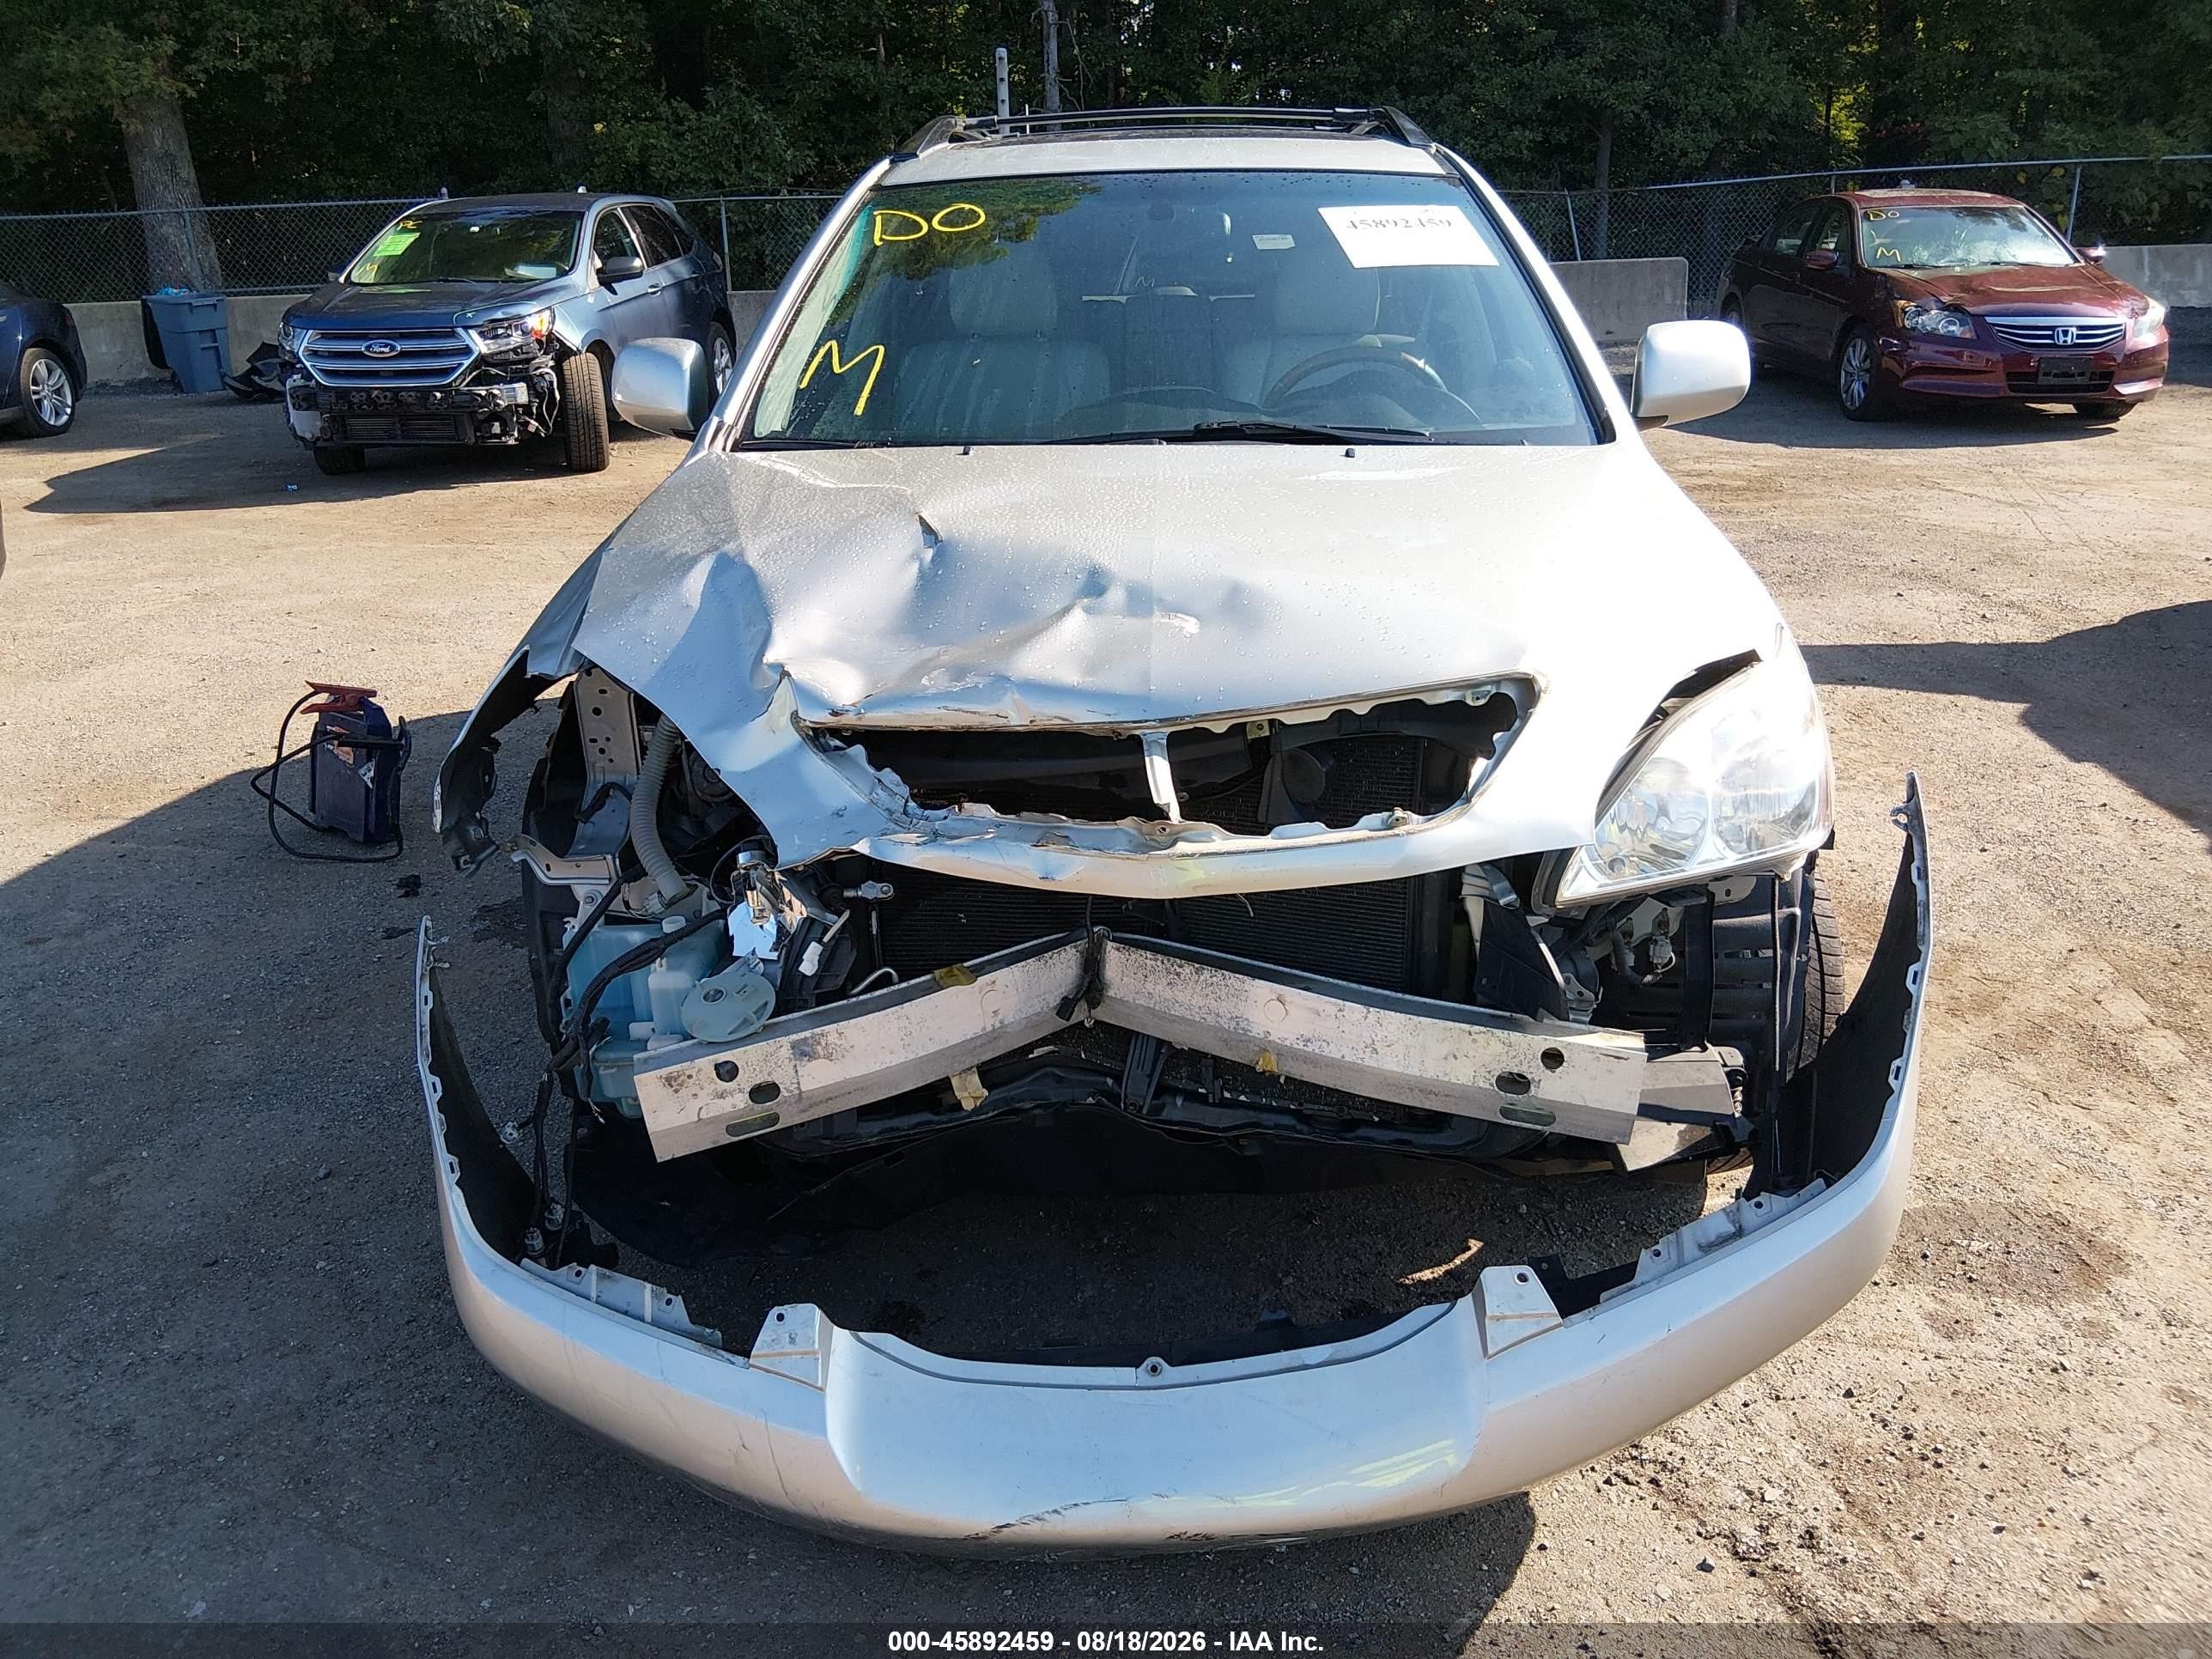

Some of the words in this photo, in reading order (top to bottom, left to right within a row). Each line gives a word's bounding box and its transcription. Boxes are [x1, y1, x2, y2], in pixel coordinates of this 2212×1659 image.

[1867, 210, 1899, 221] DO
[873, 203, 986, 246] DO
[1876, 246, 1901, 262] M
[369, 343, 392, 353] Ford
[799, 339, 885, 416] M
